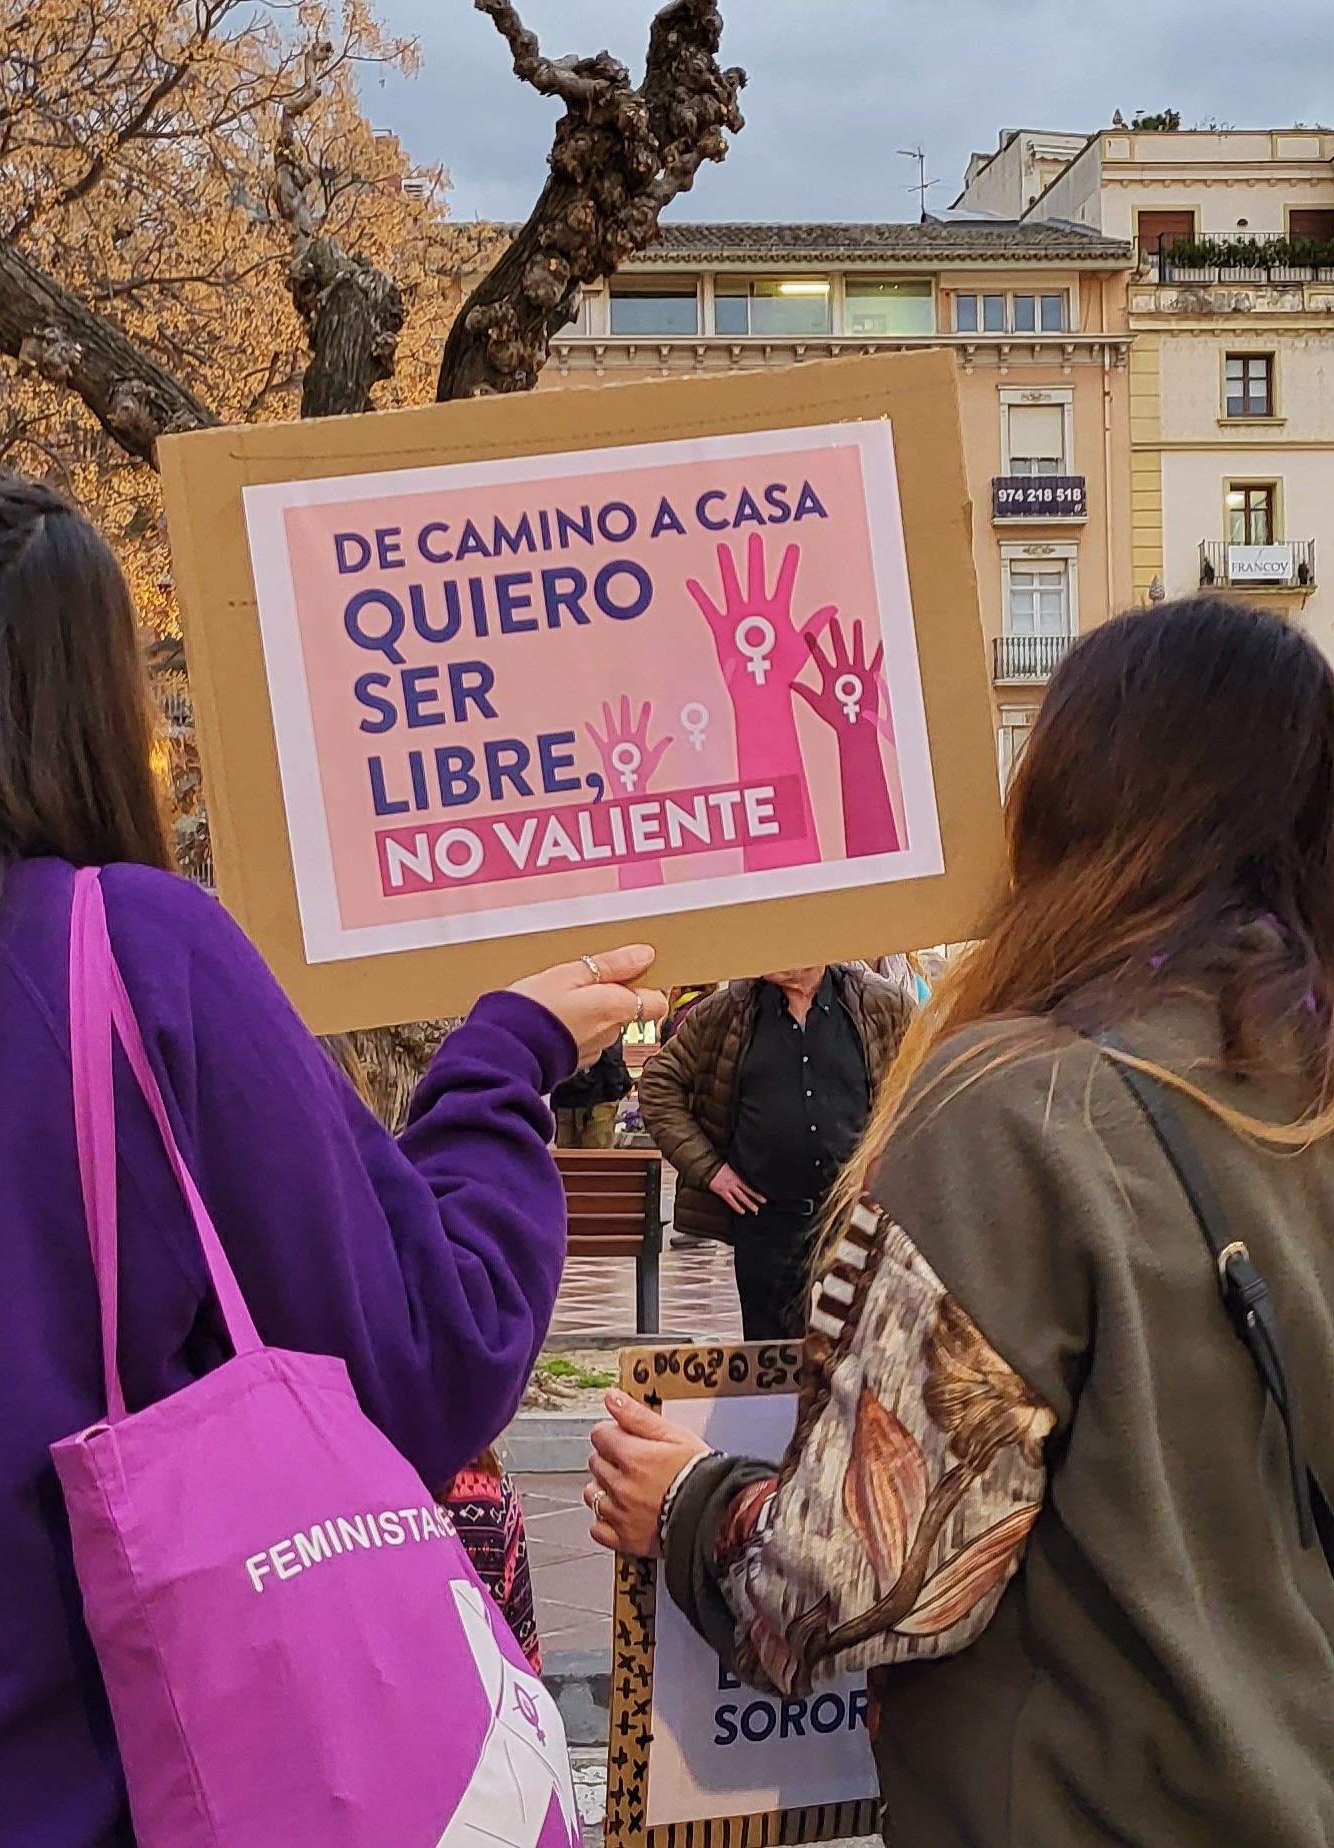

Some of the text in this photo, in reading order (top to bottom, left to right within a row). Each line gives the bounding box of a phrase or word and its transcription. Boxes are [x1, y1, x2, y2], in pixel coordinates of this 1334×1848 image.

[334, 479, 828, 574] DE CAMINO A CASA
[998, 487, 1082, 502] 974 218 518
[1231, 561, 1289, 575] FRANCOY
[344, 560, 653, 665] QUIERO
[354, 660, 499, 734] SER
[367, 730, 605, 816] LIBRE,
[383, 786, 780, 888] NO VALIENTE
